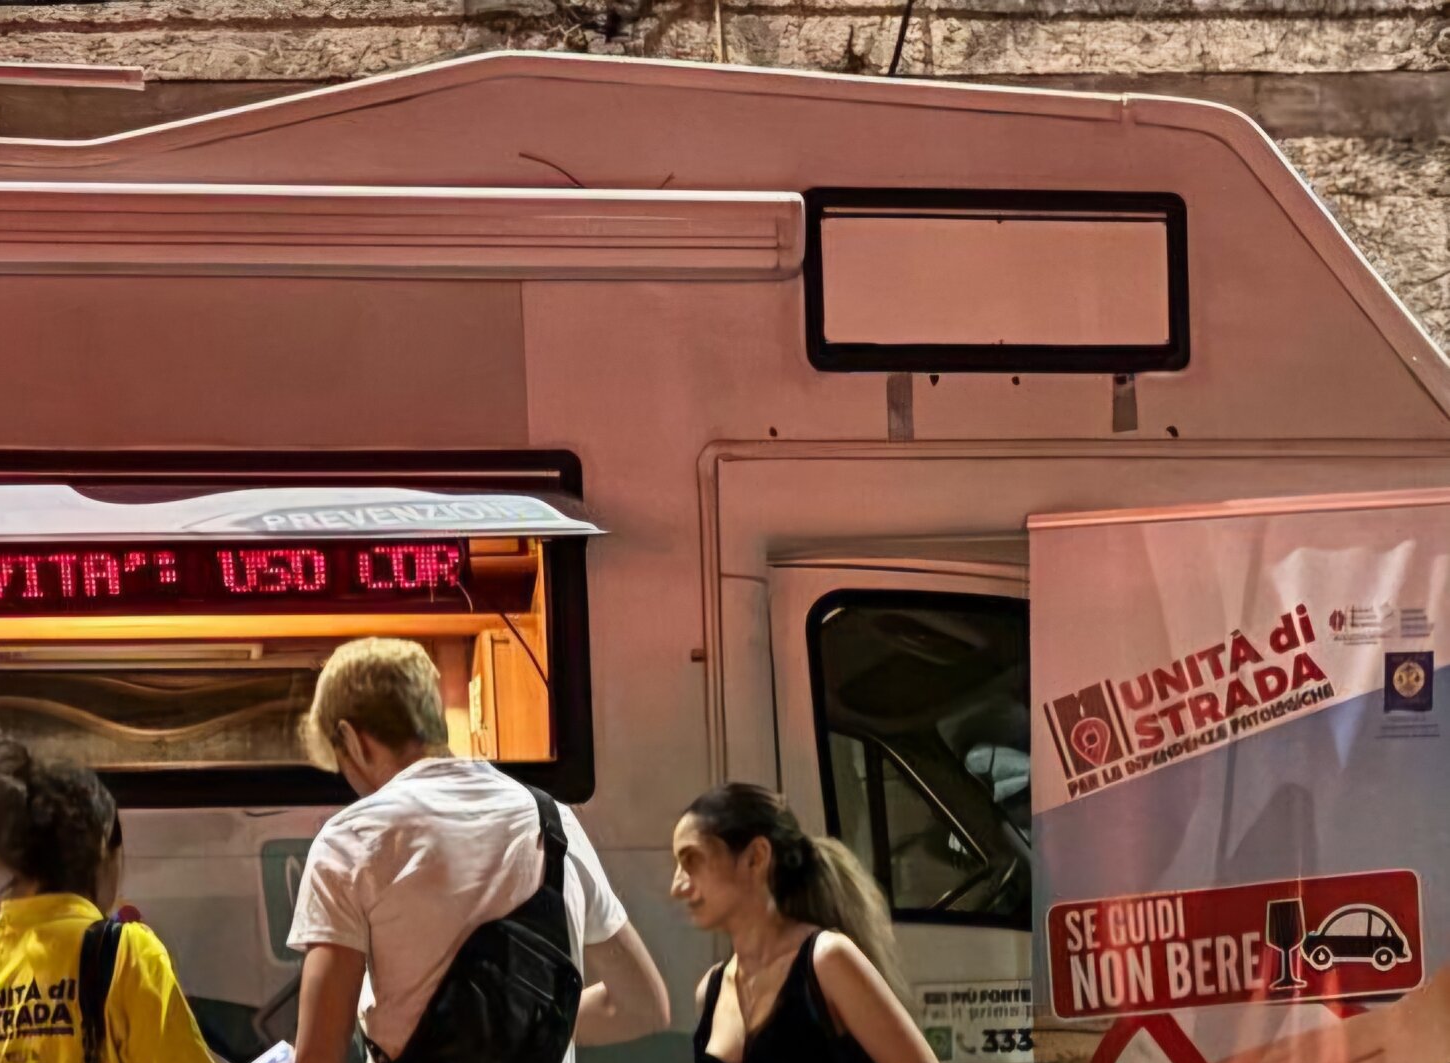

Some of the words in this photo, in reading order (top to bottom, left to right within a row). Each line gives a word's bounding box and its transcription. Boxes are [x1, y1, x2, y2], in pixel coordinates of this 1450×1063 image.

[217, 549, 326, 593] USO
[1118, 629, 1264, 711] UNITÀ
[1269, 603, 1316, 654] di
[1134, 652, 1328, 749] STRADA
[1065, 908, 1101, 951] SE
[1107, 897, 1186, 946] GUIDI
[1070, 946, 1154, 1011] NON
[1166, 931, 1265, 1000] BERE
